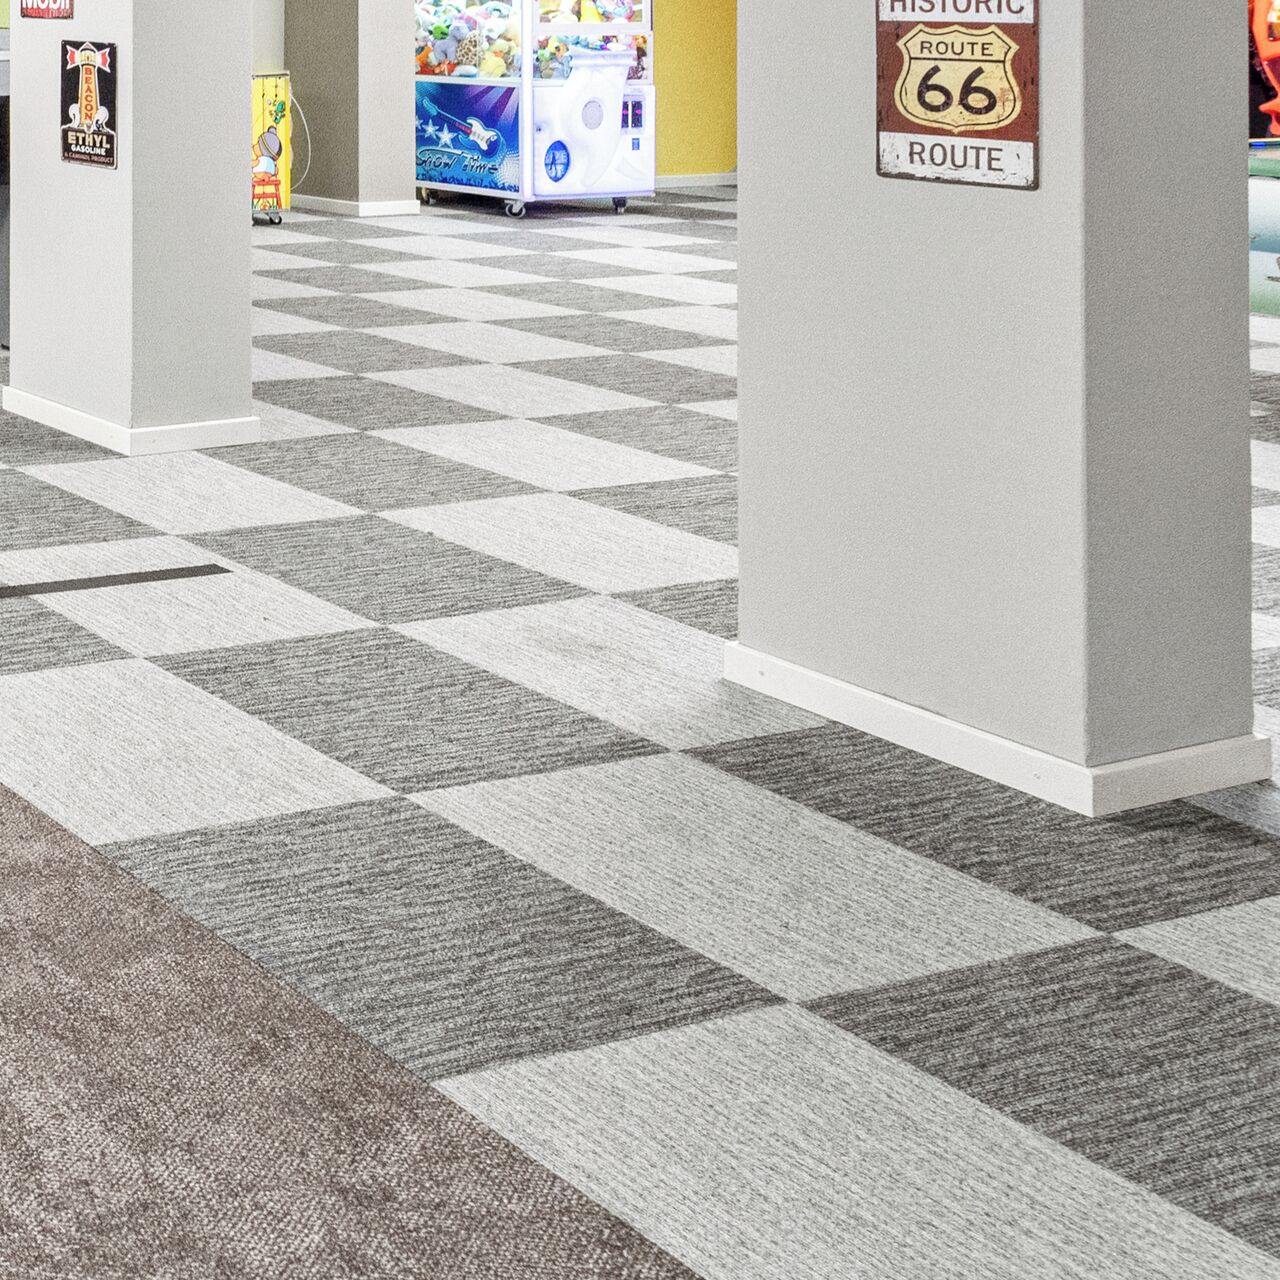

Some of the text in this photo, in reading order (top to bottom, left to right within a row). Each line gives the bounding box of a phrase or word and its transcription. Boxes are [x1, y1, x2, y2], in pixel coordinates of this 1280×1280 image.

[919, 39, 995, 58] ROUTE
[84, 67, 94, 120] BEACON
[916, 65, 997, 116] 66
[67, 131, 111, 149] ETHYL
[70, 144, 106, 156] GASOLINE
[908, 141, 1005, 173] ROUTE
